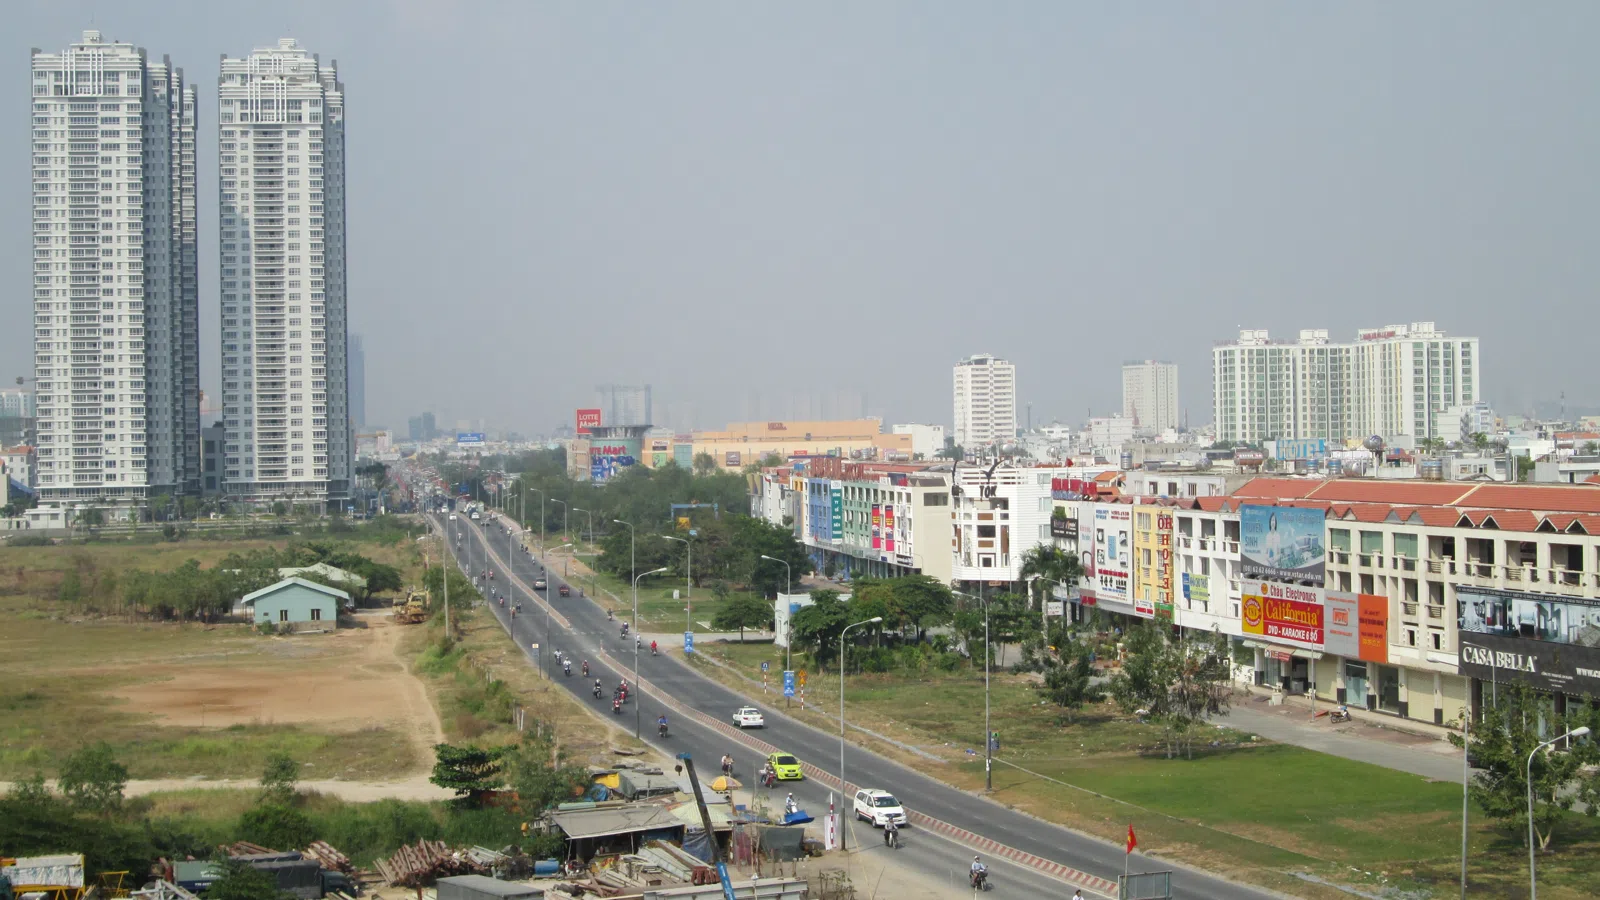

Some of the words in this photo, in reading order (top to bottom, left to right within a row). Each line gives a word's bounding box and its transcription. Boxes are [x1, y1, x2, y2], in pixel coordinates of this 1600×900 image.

[603, 445, 626, 455] Mart
[1265, 600, 1318, 626] California
[1267, 625, 1279, 635] DVD
[1281, 627, 1306, 640] KARAOKE
